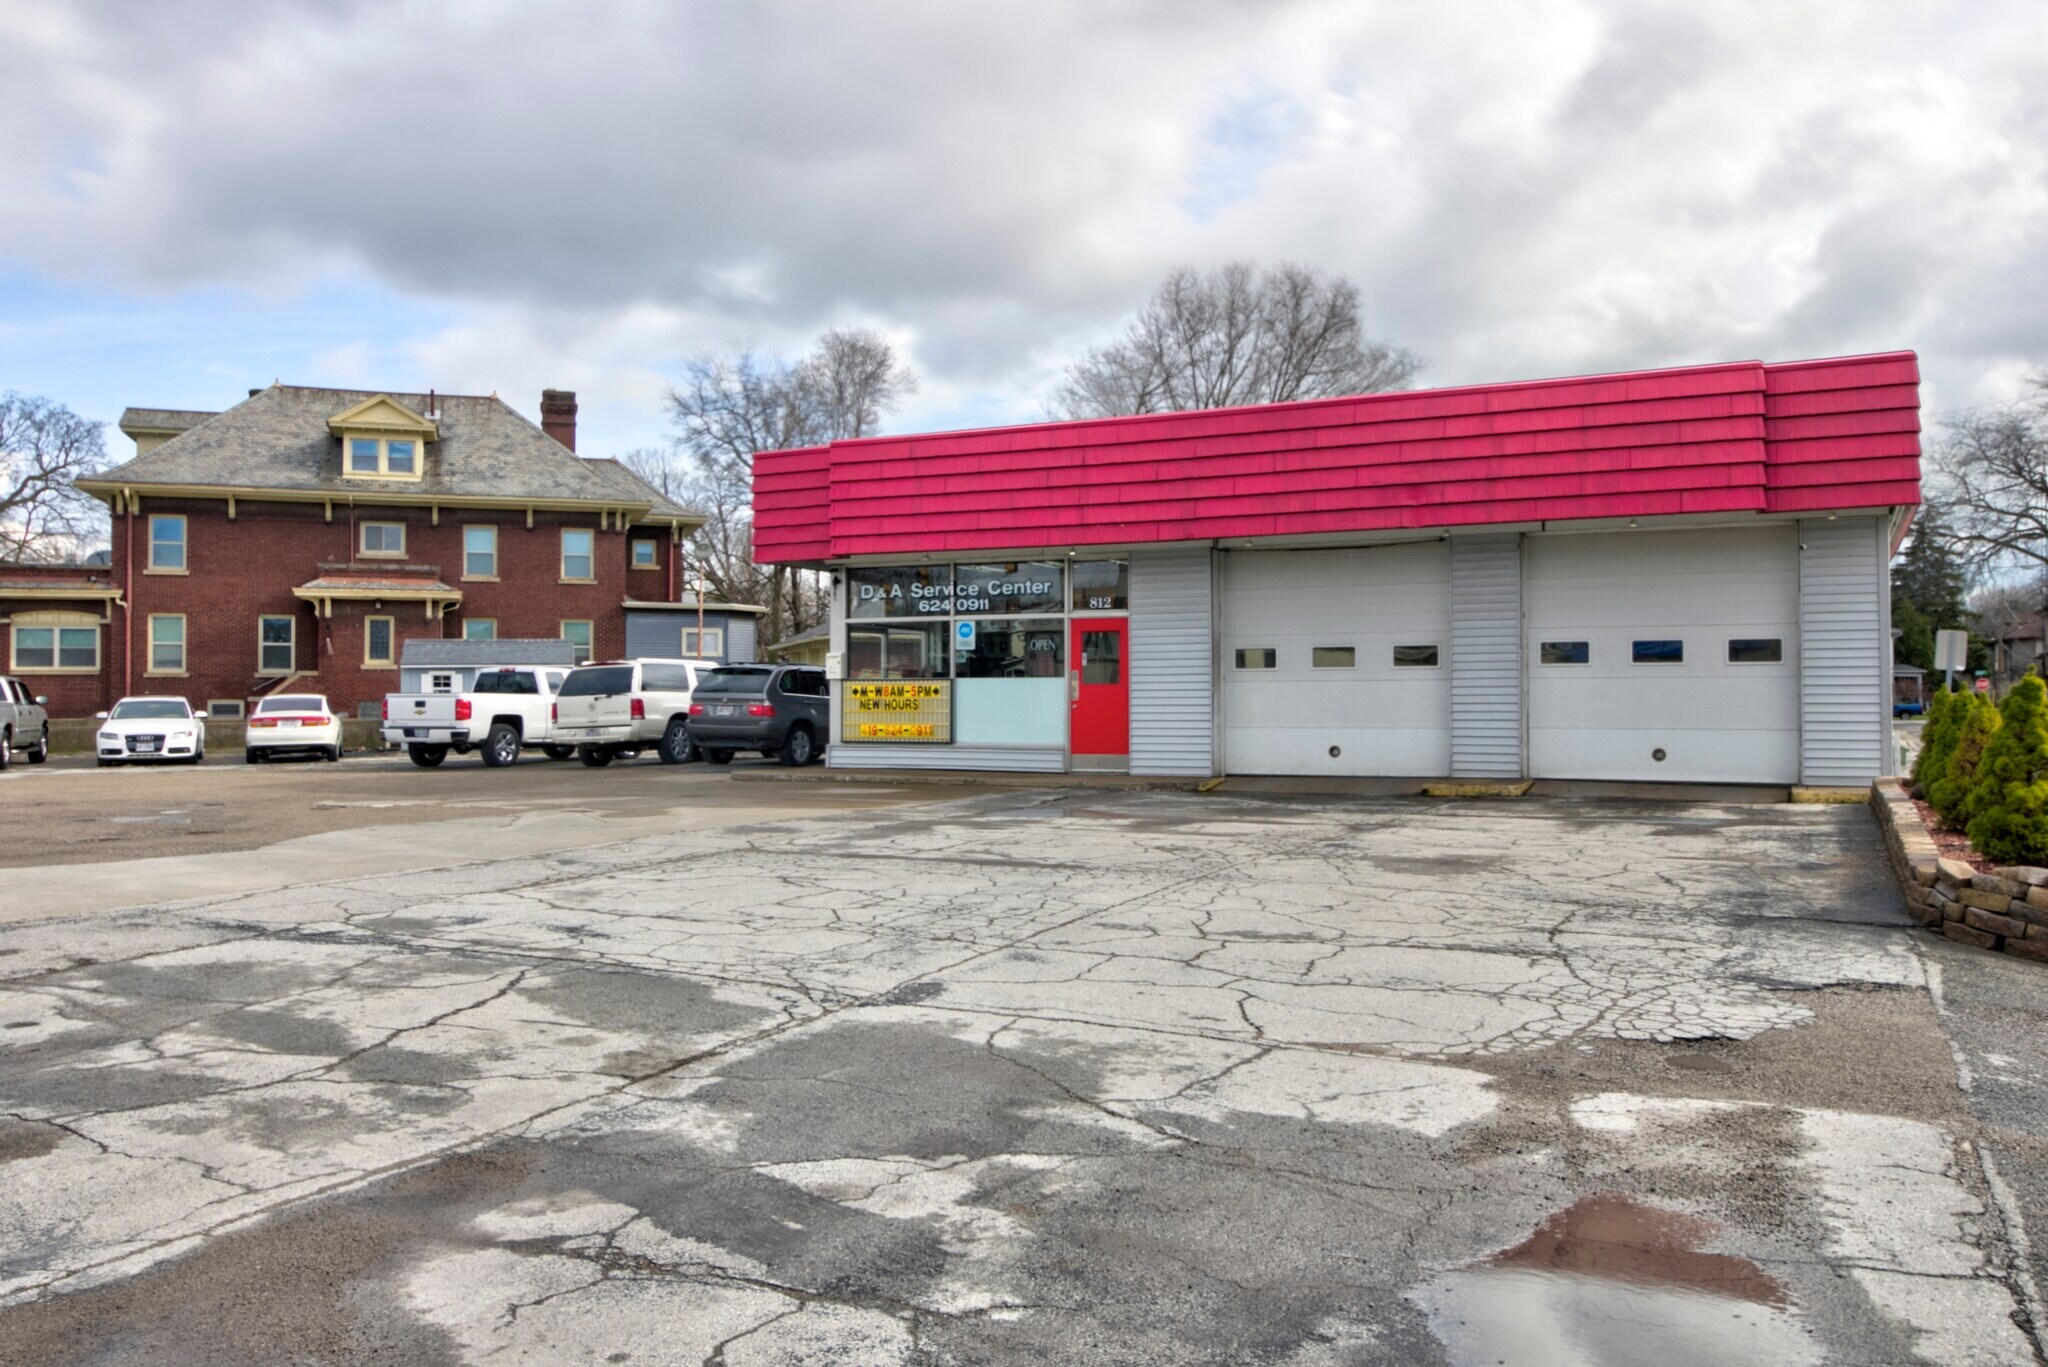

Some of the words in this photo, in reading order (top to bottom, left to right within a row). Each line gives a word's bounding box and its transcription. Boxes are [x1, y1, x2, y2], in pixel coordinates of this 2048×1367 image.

[861, 585, 874, 599] D
[876, 589, 886, 598] &
[890, 584, 902, 598] A
[911, 580, 979, 598] Service
[987, 578, 1051, 596] Center
[1089, 597, 1111, 609] 812
[1030, 639, 1057, 651] OPEN
[860, 698, 880, 710] NEW
[884, 698, 919, 710] HOURS
